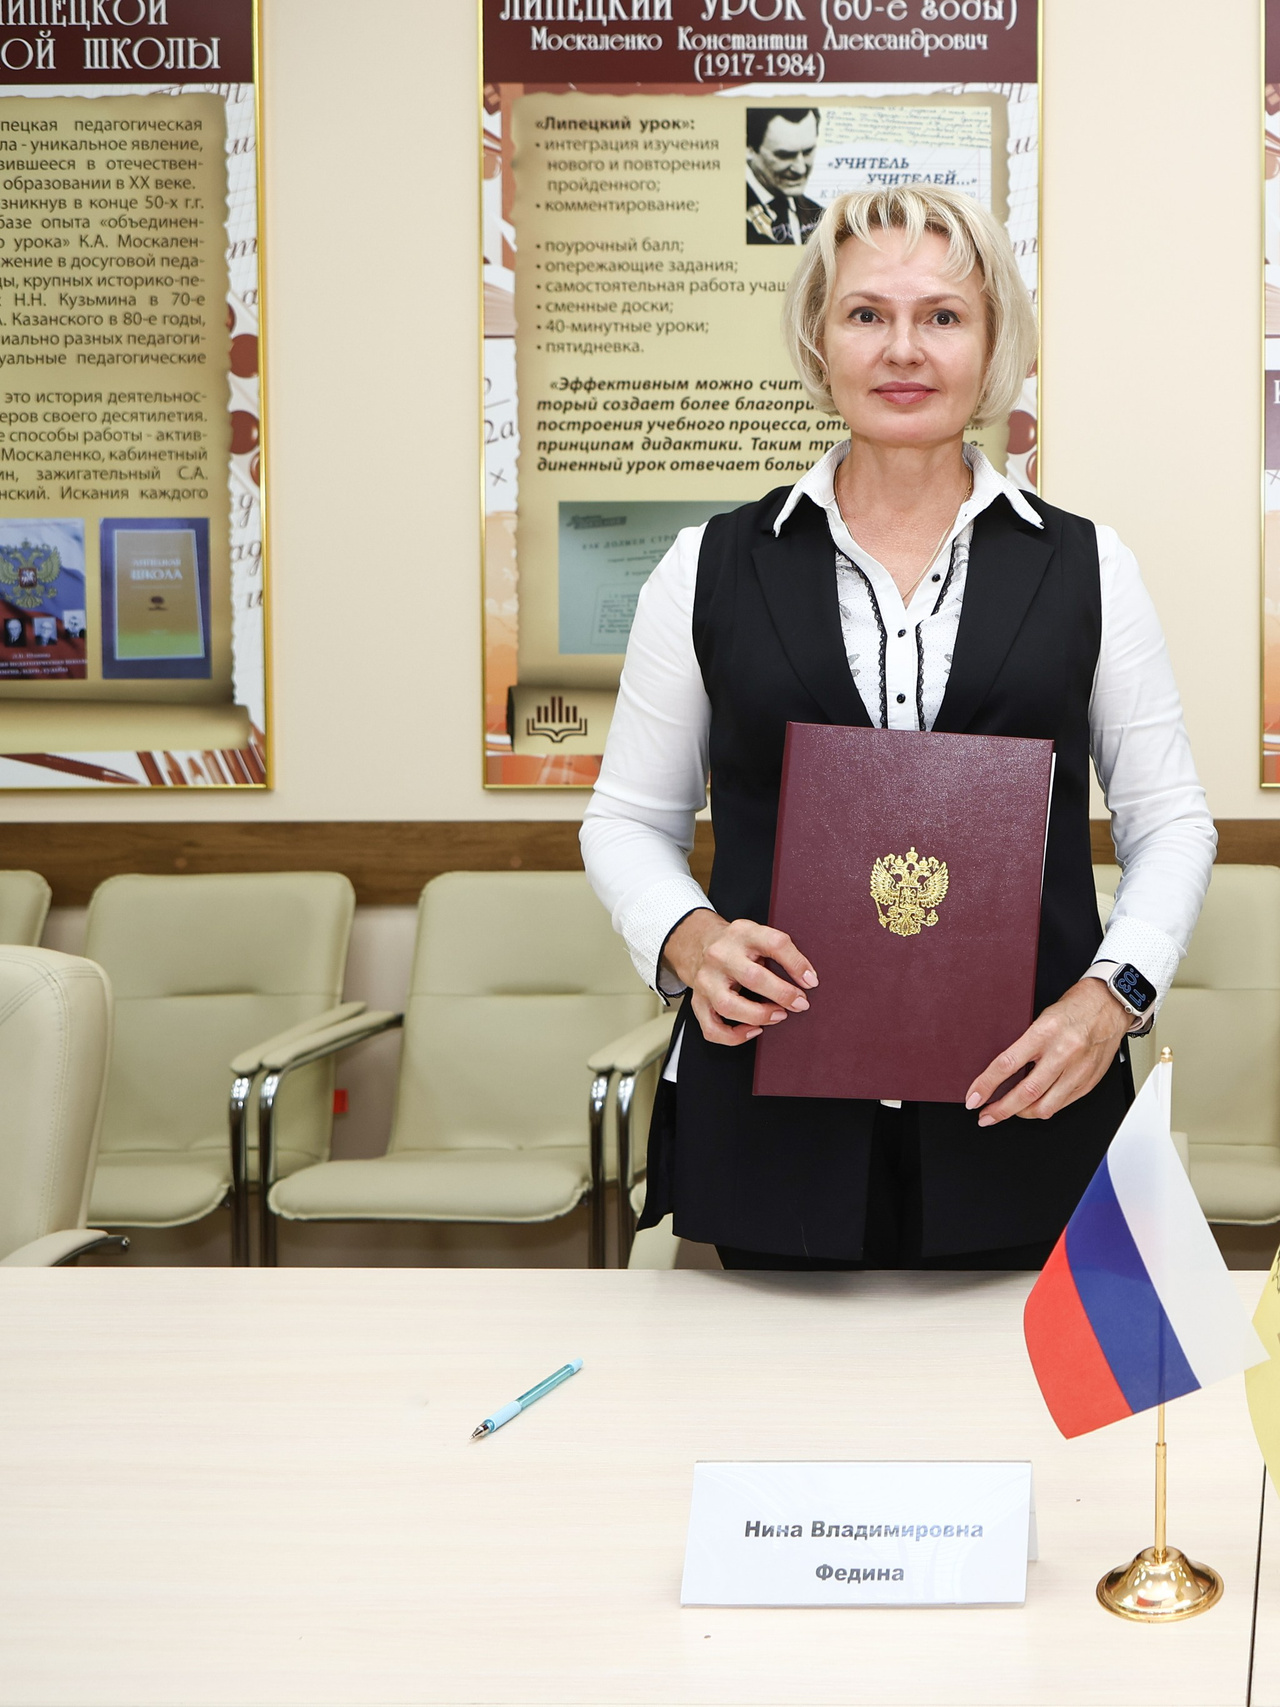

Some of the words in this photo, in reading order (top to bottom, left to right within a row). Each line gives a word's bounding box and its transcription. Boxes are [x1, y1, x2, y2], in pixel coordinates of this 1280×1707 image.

[700, 0, 806, 21] УРОК
[820, 0, 908, 29] (60-е
[922, 0, 1018, 29] годы)
[532, 26, 663, 51] Москаленко
[677, 26, 808, 51] Константин
[823, 25, 988, 57] Александрович
[83, 37, 221, 70] ШКОЛЫ
[694, 52, 826, 82] (1917-1984)
[74, 120, 203, 134] педагогическая
[535, 115, 632, 133] «Липецкий
[639, 119, 695, 134] урок»:
[29, 139, 128, 153] уникальное
[131, 139, 203, 153] явление,
[544, 139, 639, 154] интеграция
[642, 139, 720, 154] изучения
[547, 159, 606, 172] нового
[608, 159, 620, 171] и
[623, 159, 721, 174] повторения
[2, 176, 112, 191] образовании
[115, 178, 125, 190] в
[154, 178, 196, 190] веке.
[547, 177, 661, 195] пройденного;
[73, 198, 83, 210] в
[89, 198, 139, 212] конце
[145, 196, 179, 210] 50-х
[184, 197, 204, 209] г.г.
[544, 200, 700, 215] комментирование;
[40, 217, 91, 230] опыта
[99, 214, 204, 231] «объединен-
[13, 237, 71, 251] урока»
[79, 234, 109, 249] К.А.
[117, 234, 203, 249] Москален-
[544, 237, 638, 256] поурочный
[641, 236, 684, 254] балл;
[544, 260, 665, 276] опережающие
[668, 260, 738, 275] задания;
[545, 280, 685, 293] самостоятельная
[689, 277, 745, 296] работа
[545, 301, 618, 313] сменные
[620, 301, 674, 315] доски;
[11, 312, 104, 327] Казанского
[108, 314, 119, 326] в
[122, 312, 158, 326] 80-е
[162, 314, 206, 328] годы,
[545, 318, 653, 336] 40-минутные
[655, 321, 709, 336] уроки;
[545, 341, 645, 356] пятидневка.
[550, 376, 690, 394] «Эффективным
[695, 379, 754, 391] можно
[536, 396, 598, 414] торый
[602, 395, 675, 412] создает
[680, 395, 730, 411] более
[536, 420, 644, 435] построения
[646, 416, 726, 435] учебного
[728, 420, 811, 435] процесса,
[537, 440, 634, 455] принципам
[641, 436, 743, 451] дидактики.
[751, 436, 802, 451] Таким
[0, 447, 106, 463] Москаленко,
[108, 447, 208, 462] кабинетный
[536, 456, 623, 472] диненный
[625, 460, 667, 475] урок
[669, 460, 761, 472] отвечает
[744, 1520, 803, 1538] Нина
[810, 1519, 984, 1542] Владимировна
[815, 1563, 905, 1585] Федина
